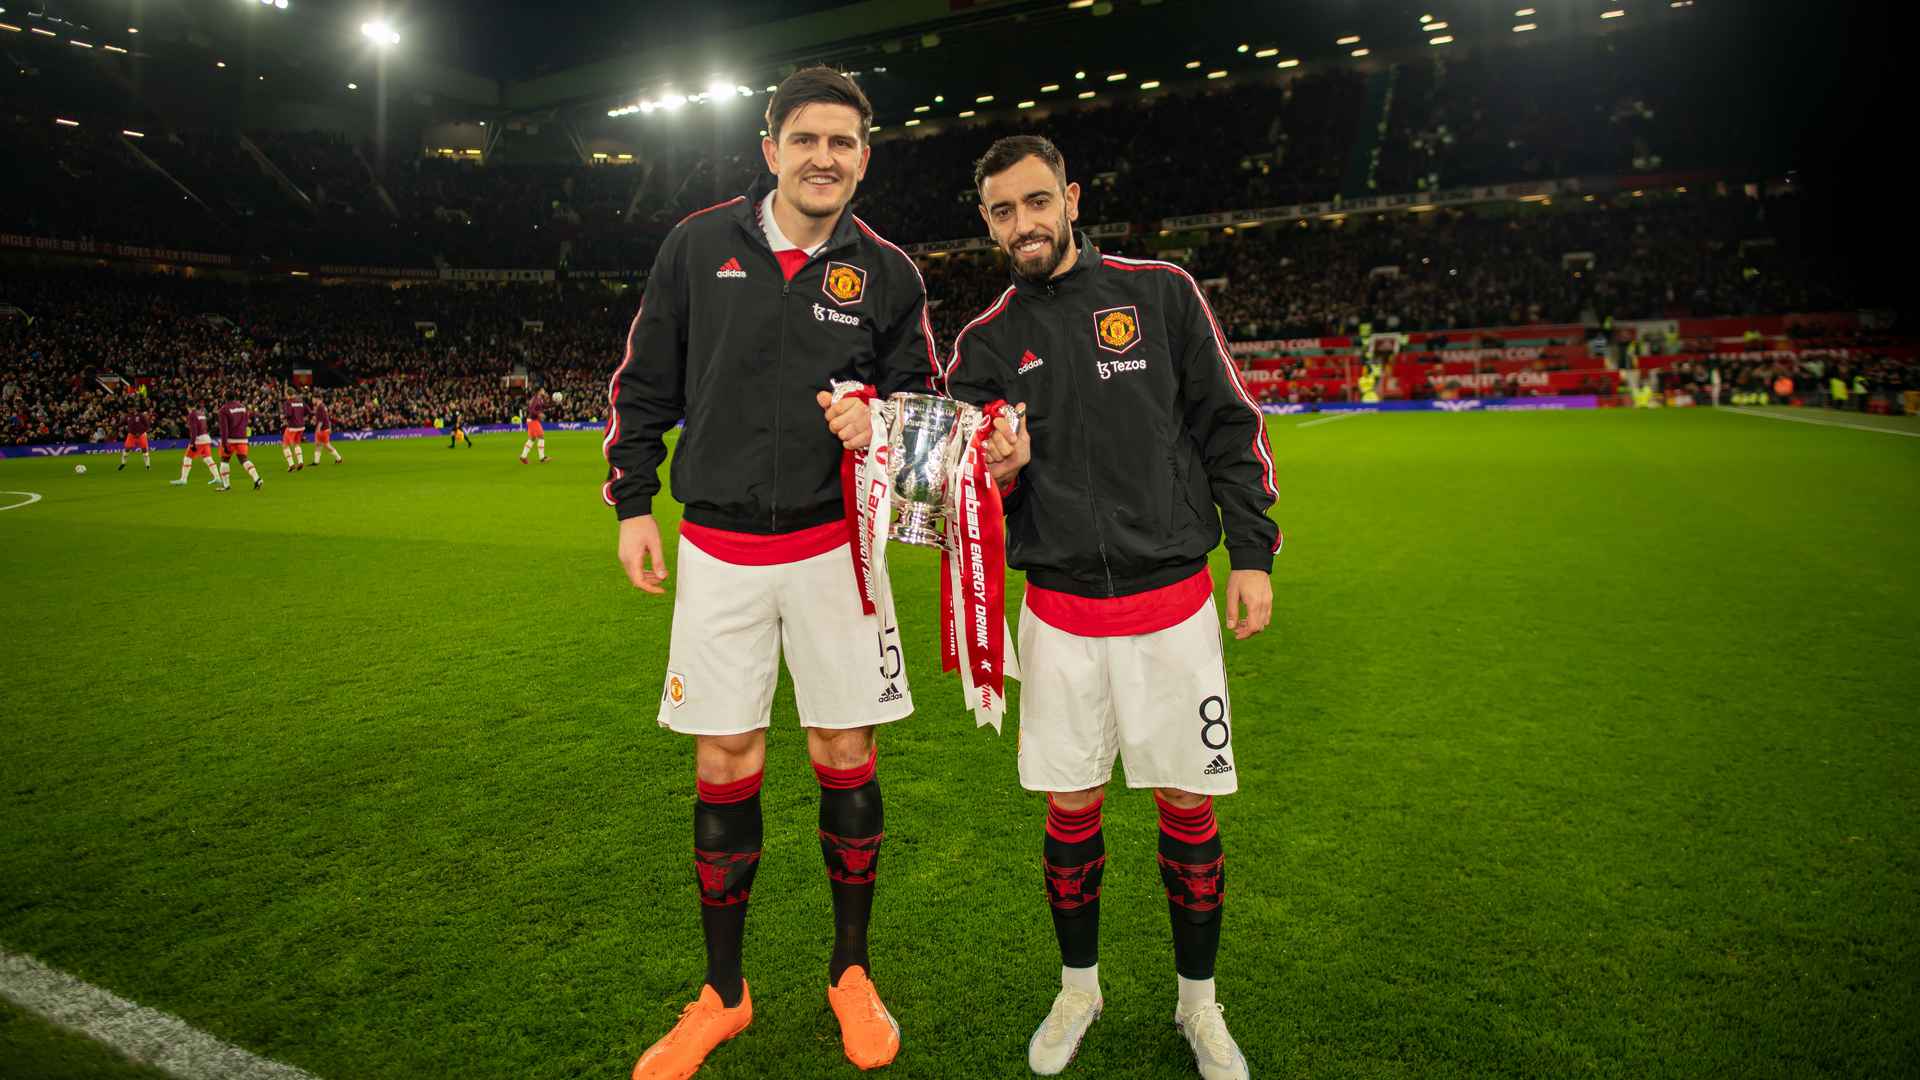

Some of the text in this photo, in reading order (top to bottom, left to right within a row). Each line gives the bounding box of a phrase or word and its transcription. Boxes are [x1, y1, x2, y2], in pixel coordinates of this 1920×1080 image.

[716, 269, 747, 278] adidas
[827, 308, 860, 326] Tezos
[1018, 357, 1044, 375] adidas
[1109, 358, 1147, 373] Tezos
[964, 446, 989, 651] Carabao ENERGY DRINK
[878, 626, 901, 680] 5
[878, 692, 903, 703] adidas
[1199, 695, 1230, 750] 8
[1203, 765, 1233, 775] adidas
